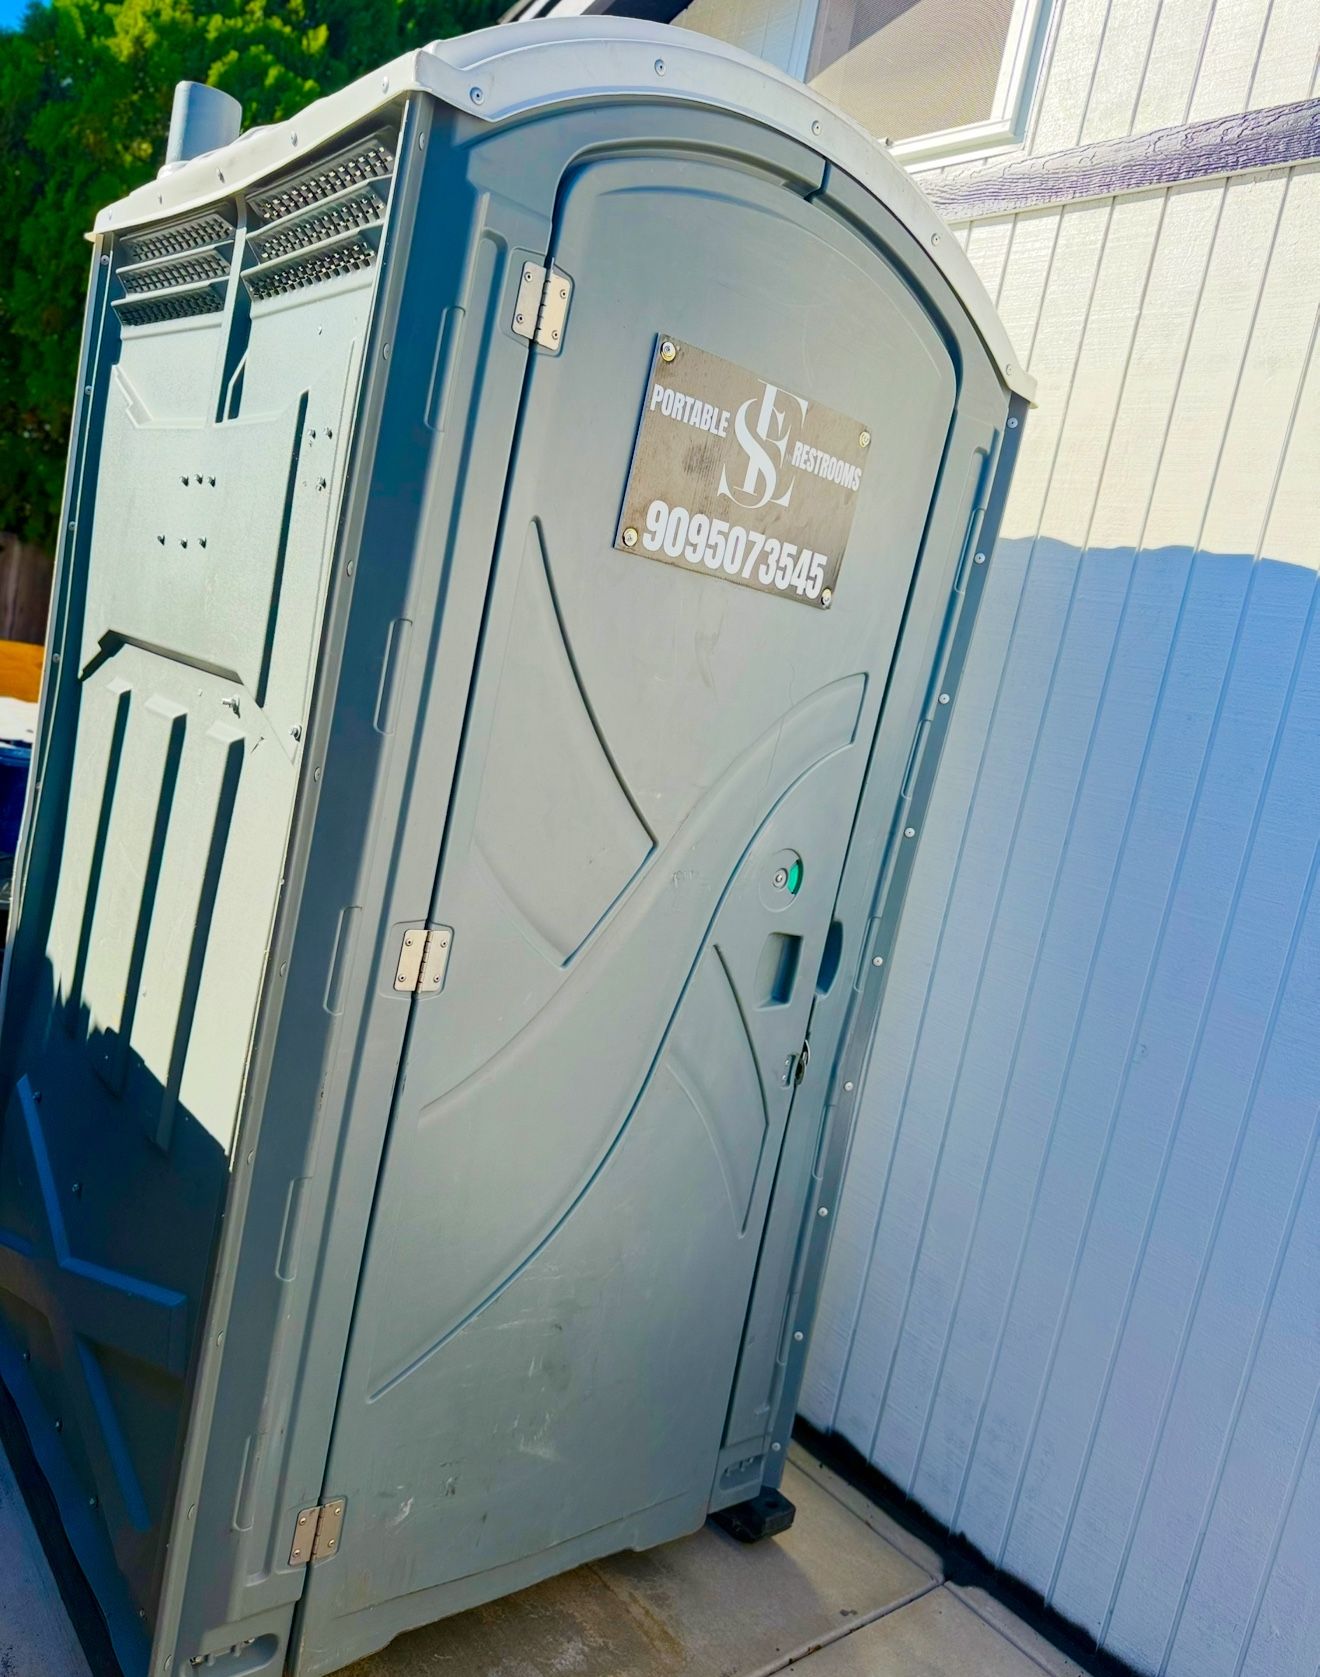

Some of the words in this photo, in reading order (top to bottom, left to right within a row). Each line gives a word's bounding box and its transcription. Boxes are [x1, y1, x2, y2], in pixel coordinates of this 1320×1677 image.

[650, 384, 730, 438] PORTABLE
[791, 441, 862, 492] RESTROOMS
[642, 500, 828, 599] 9095073545
